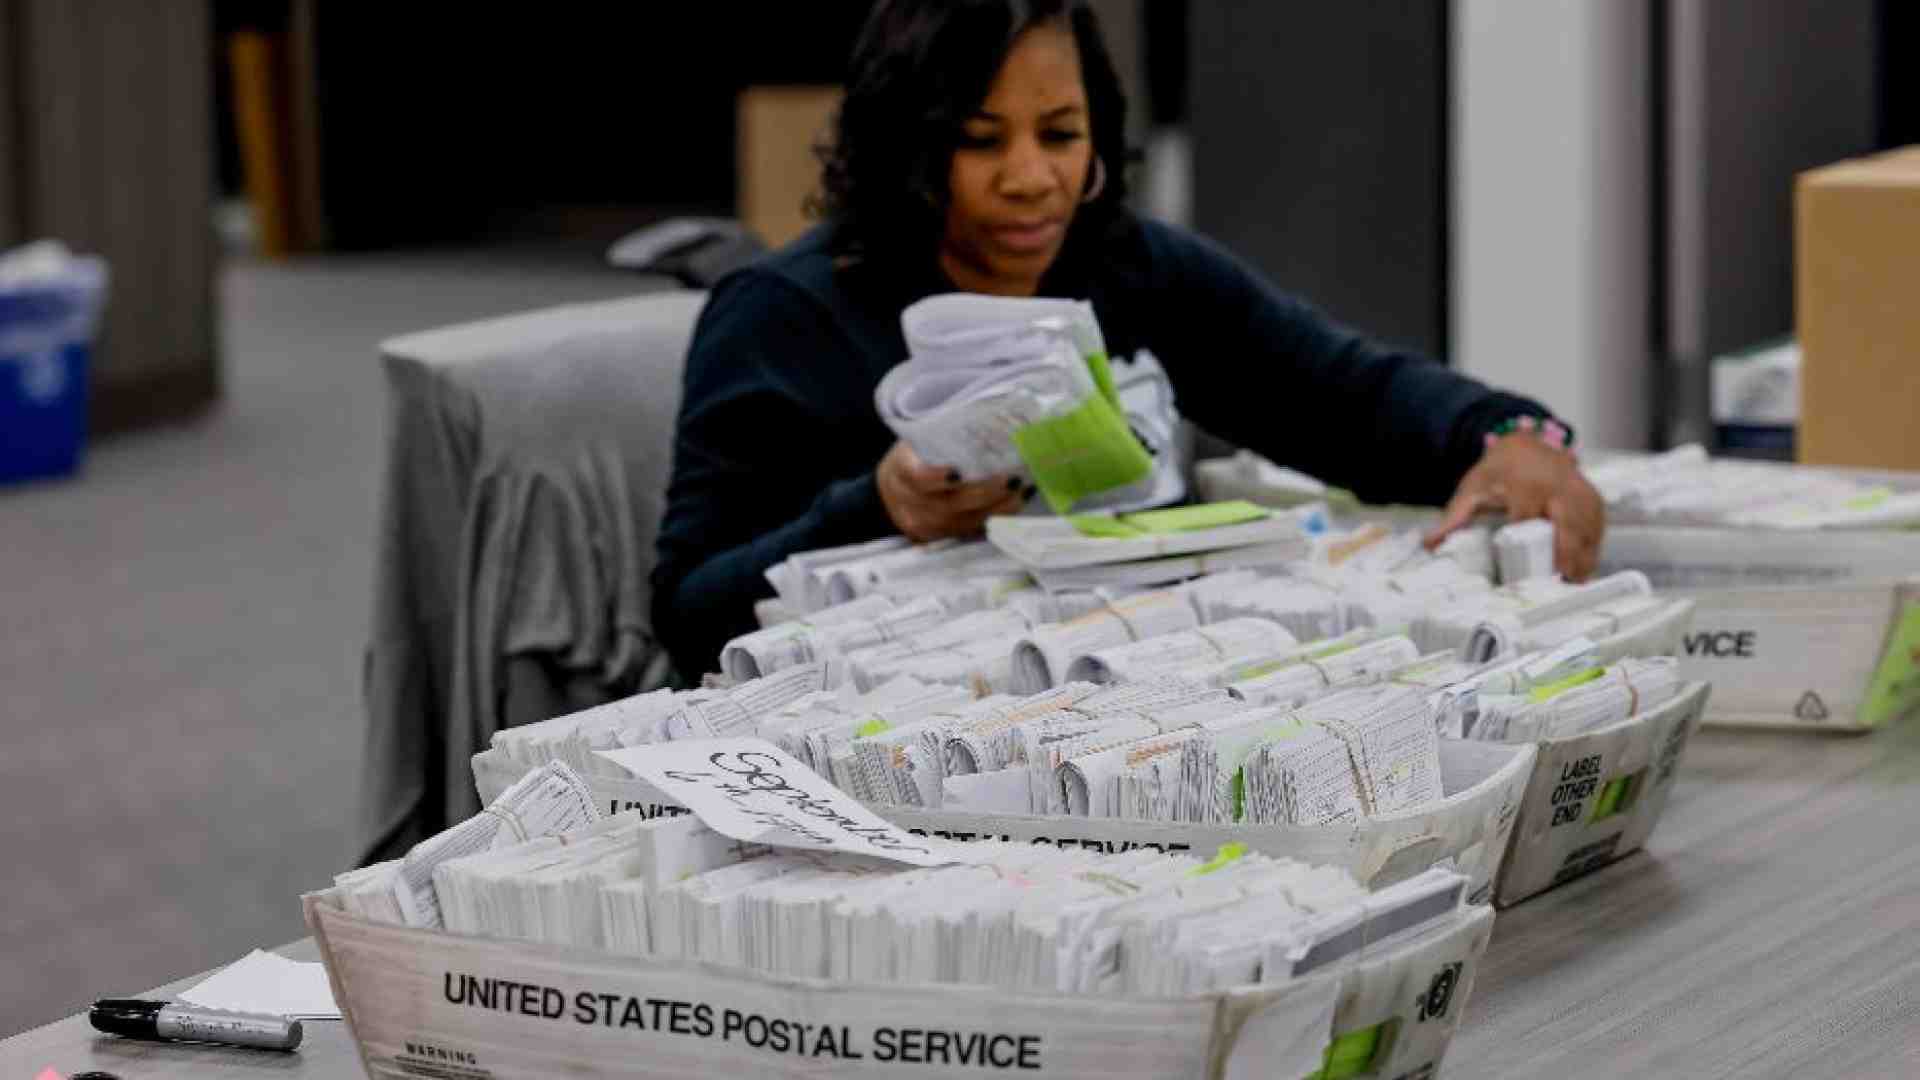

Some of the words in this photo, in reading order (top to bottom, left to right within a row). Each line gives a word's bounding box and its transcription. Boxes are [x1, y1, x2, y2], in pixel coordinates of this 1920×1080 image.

[1682, 631, 1756, 658] VICE
[1561, 753, 1602, 781] LABEL
[1551, 777, 1599, 805] OTHER
[1551, 801, 1582, 827] END
[443, 971, 566, 1020] UNITED
[574, 991, 714, 1038] STATES
[722, 1008, 864, 1060] POSTAL
[871, 1026, 1042, 1070] SERVICE
[406, 1042, 477, 1065] WARNING
